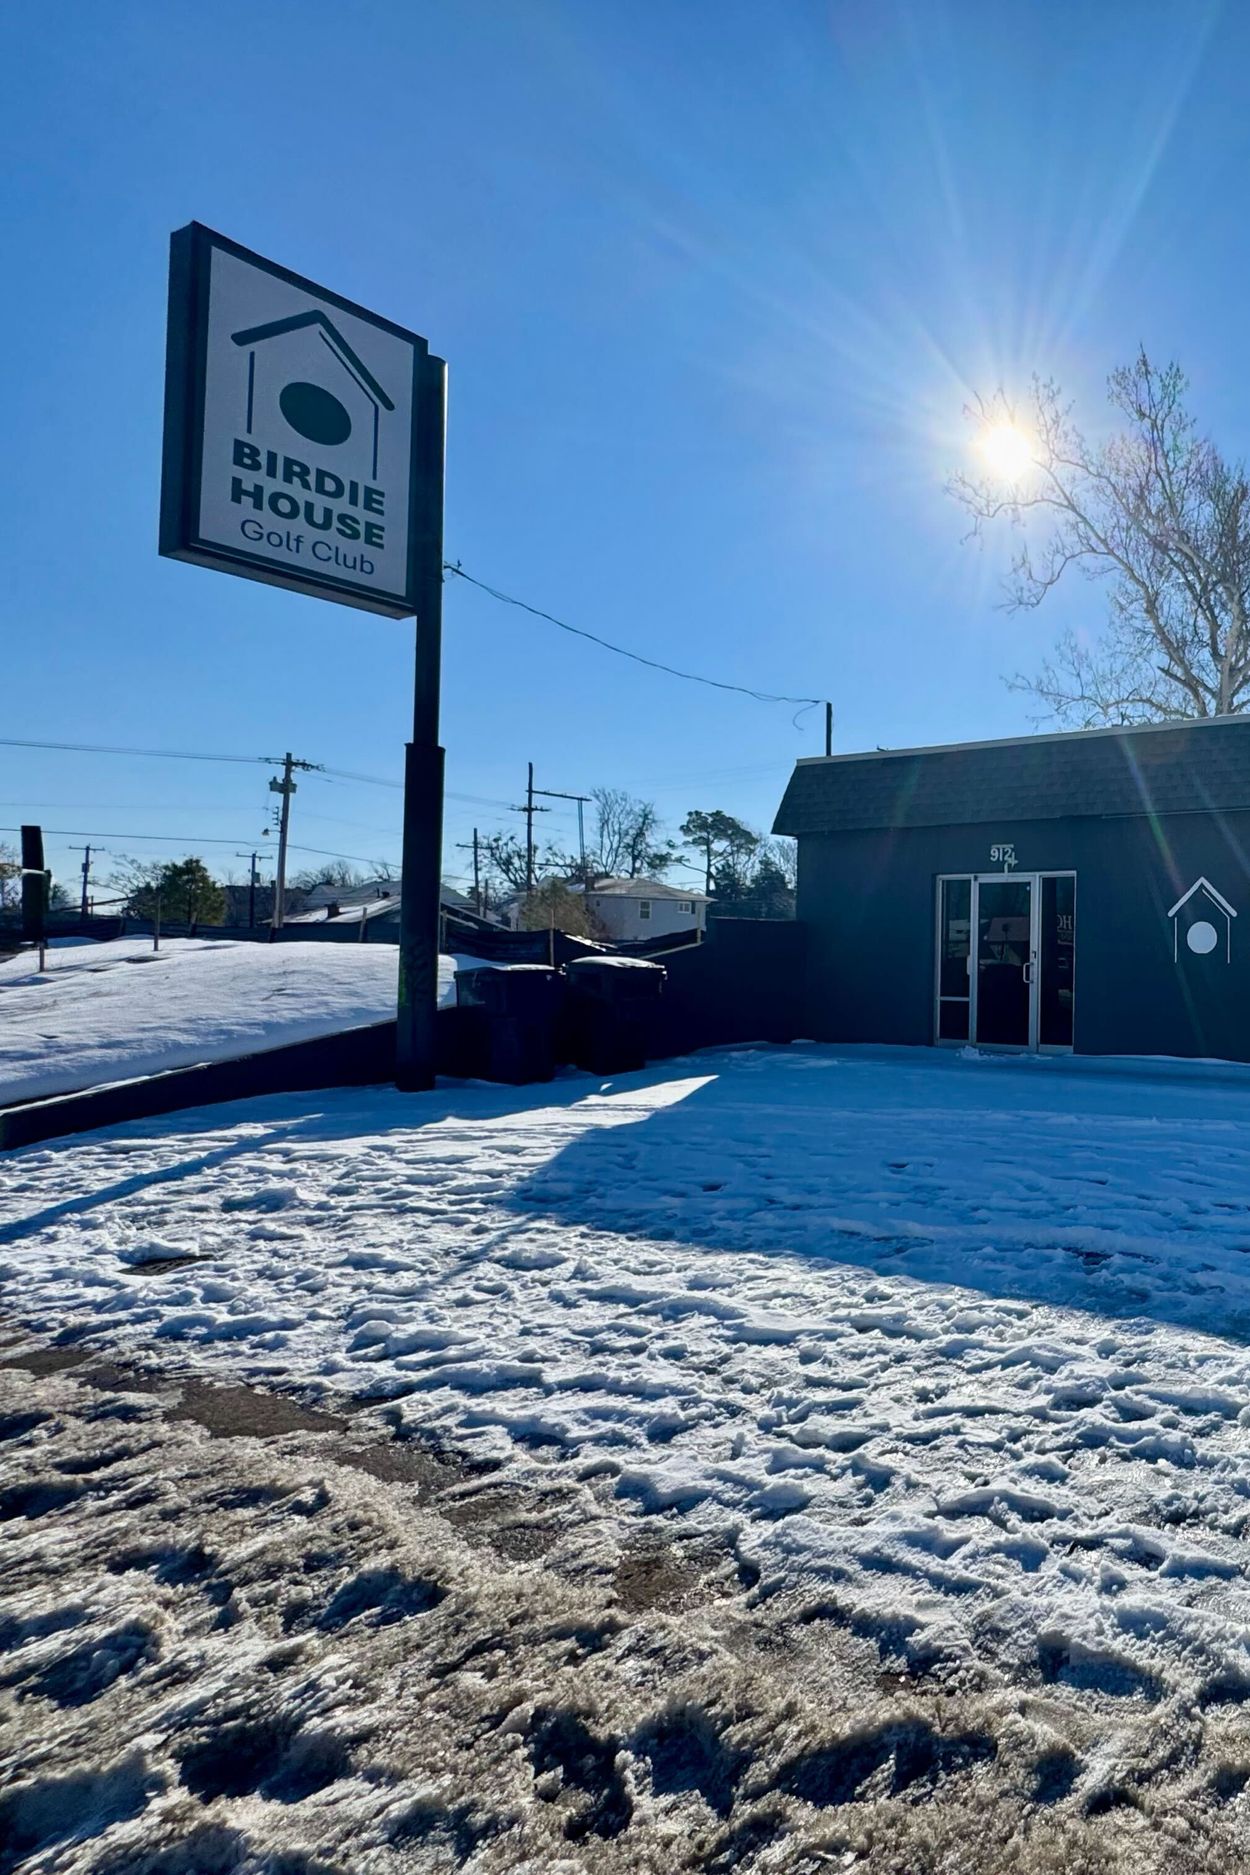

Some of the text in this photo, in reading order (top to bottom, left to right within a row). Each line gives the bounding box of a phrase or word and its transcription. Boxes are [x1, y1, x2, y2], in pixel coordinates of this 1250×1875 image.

[232, 438, 385, 516] BIRDIE
[230, 476, 385, 550] HOUSE
[240, 519, 375, 575] Golf Club
[990, 847, 1012, 861] 912
